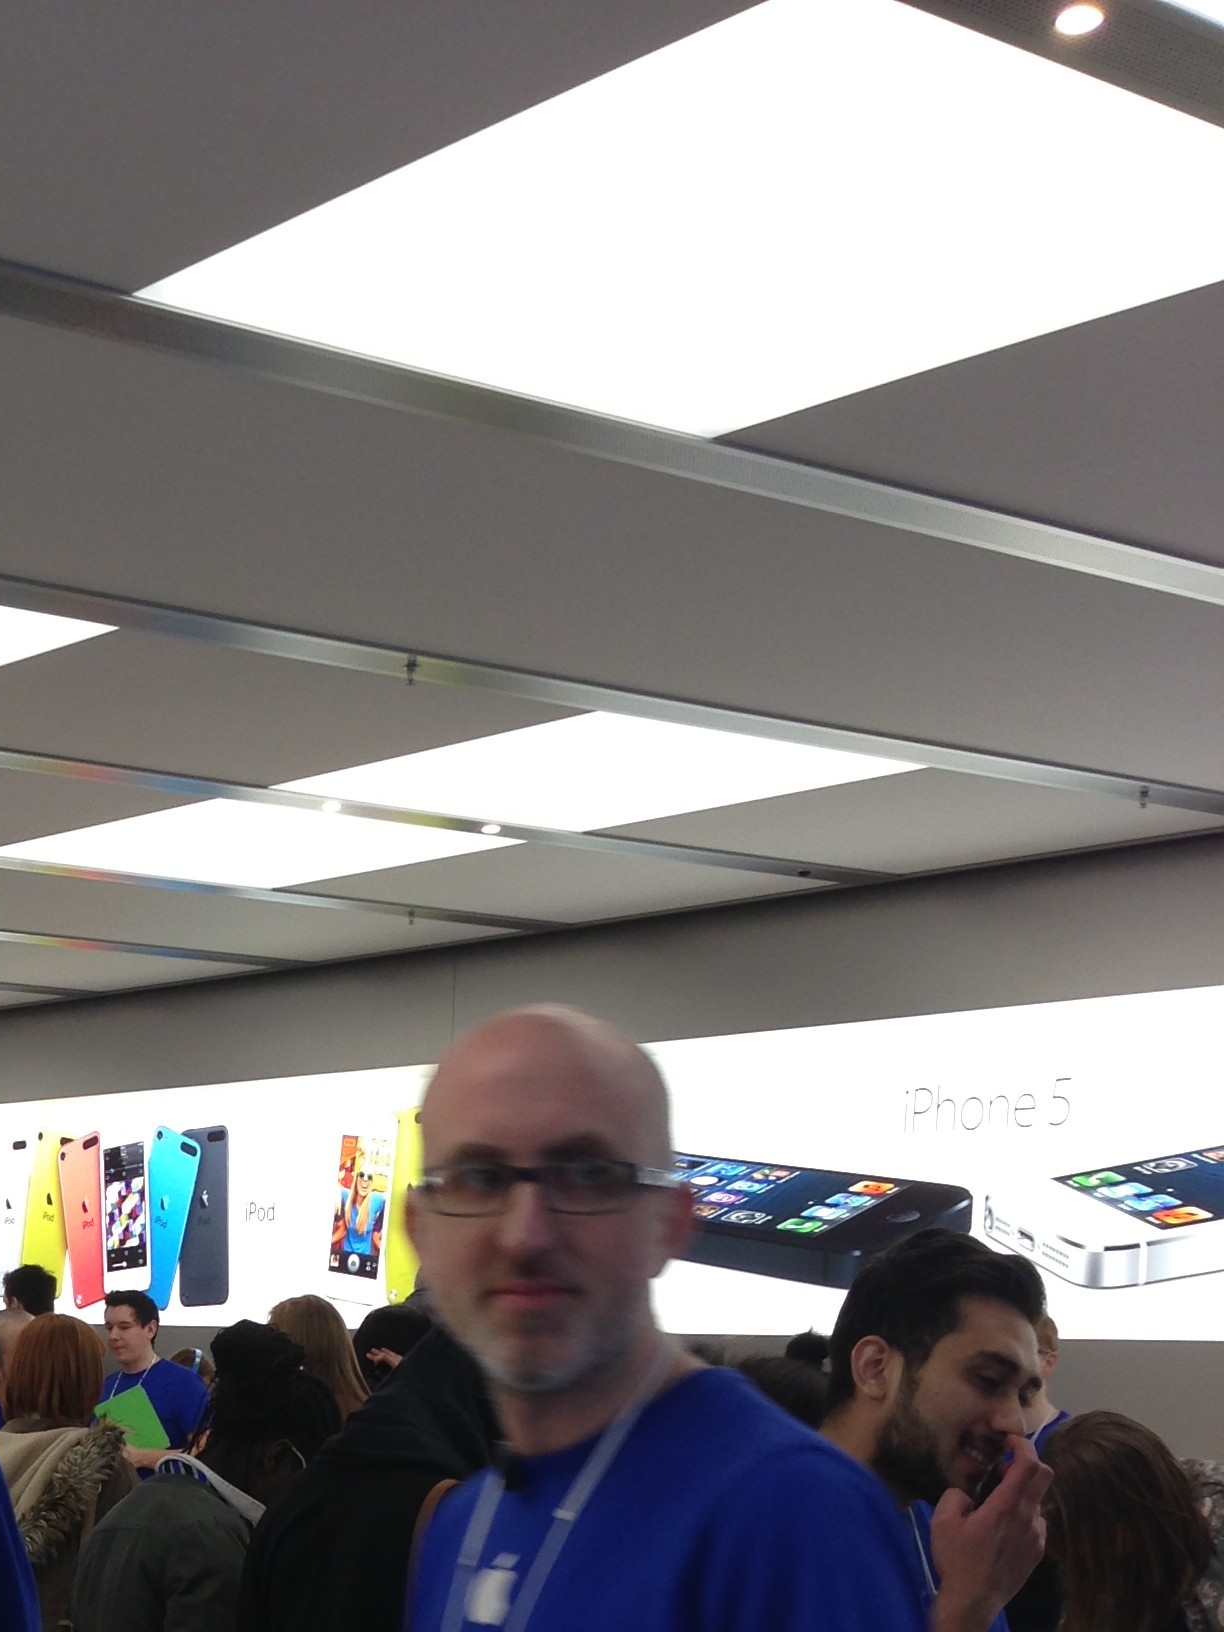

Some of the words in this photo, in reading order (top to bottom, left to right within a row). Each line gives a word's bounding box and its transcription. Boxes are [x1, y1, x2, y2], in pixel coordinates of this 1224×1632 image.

[903, 1084, 1036, 1134] iPhone
[1048, 1077, 1072, 1127] 5
[244, 1202, 276, 1223] iPod
